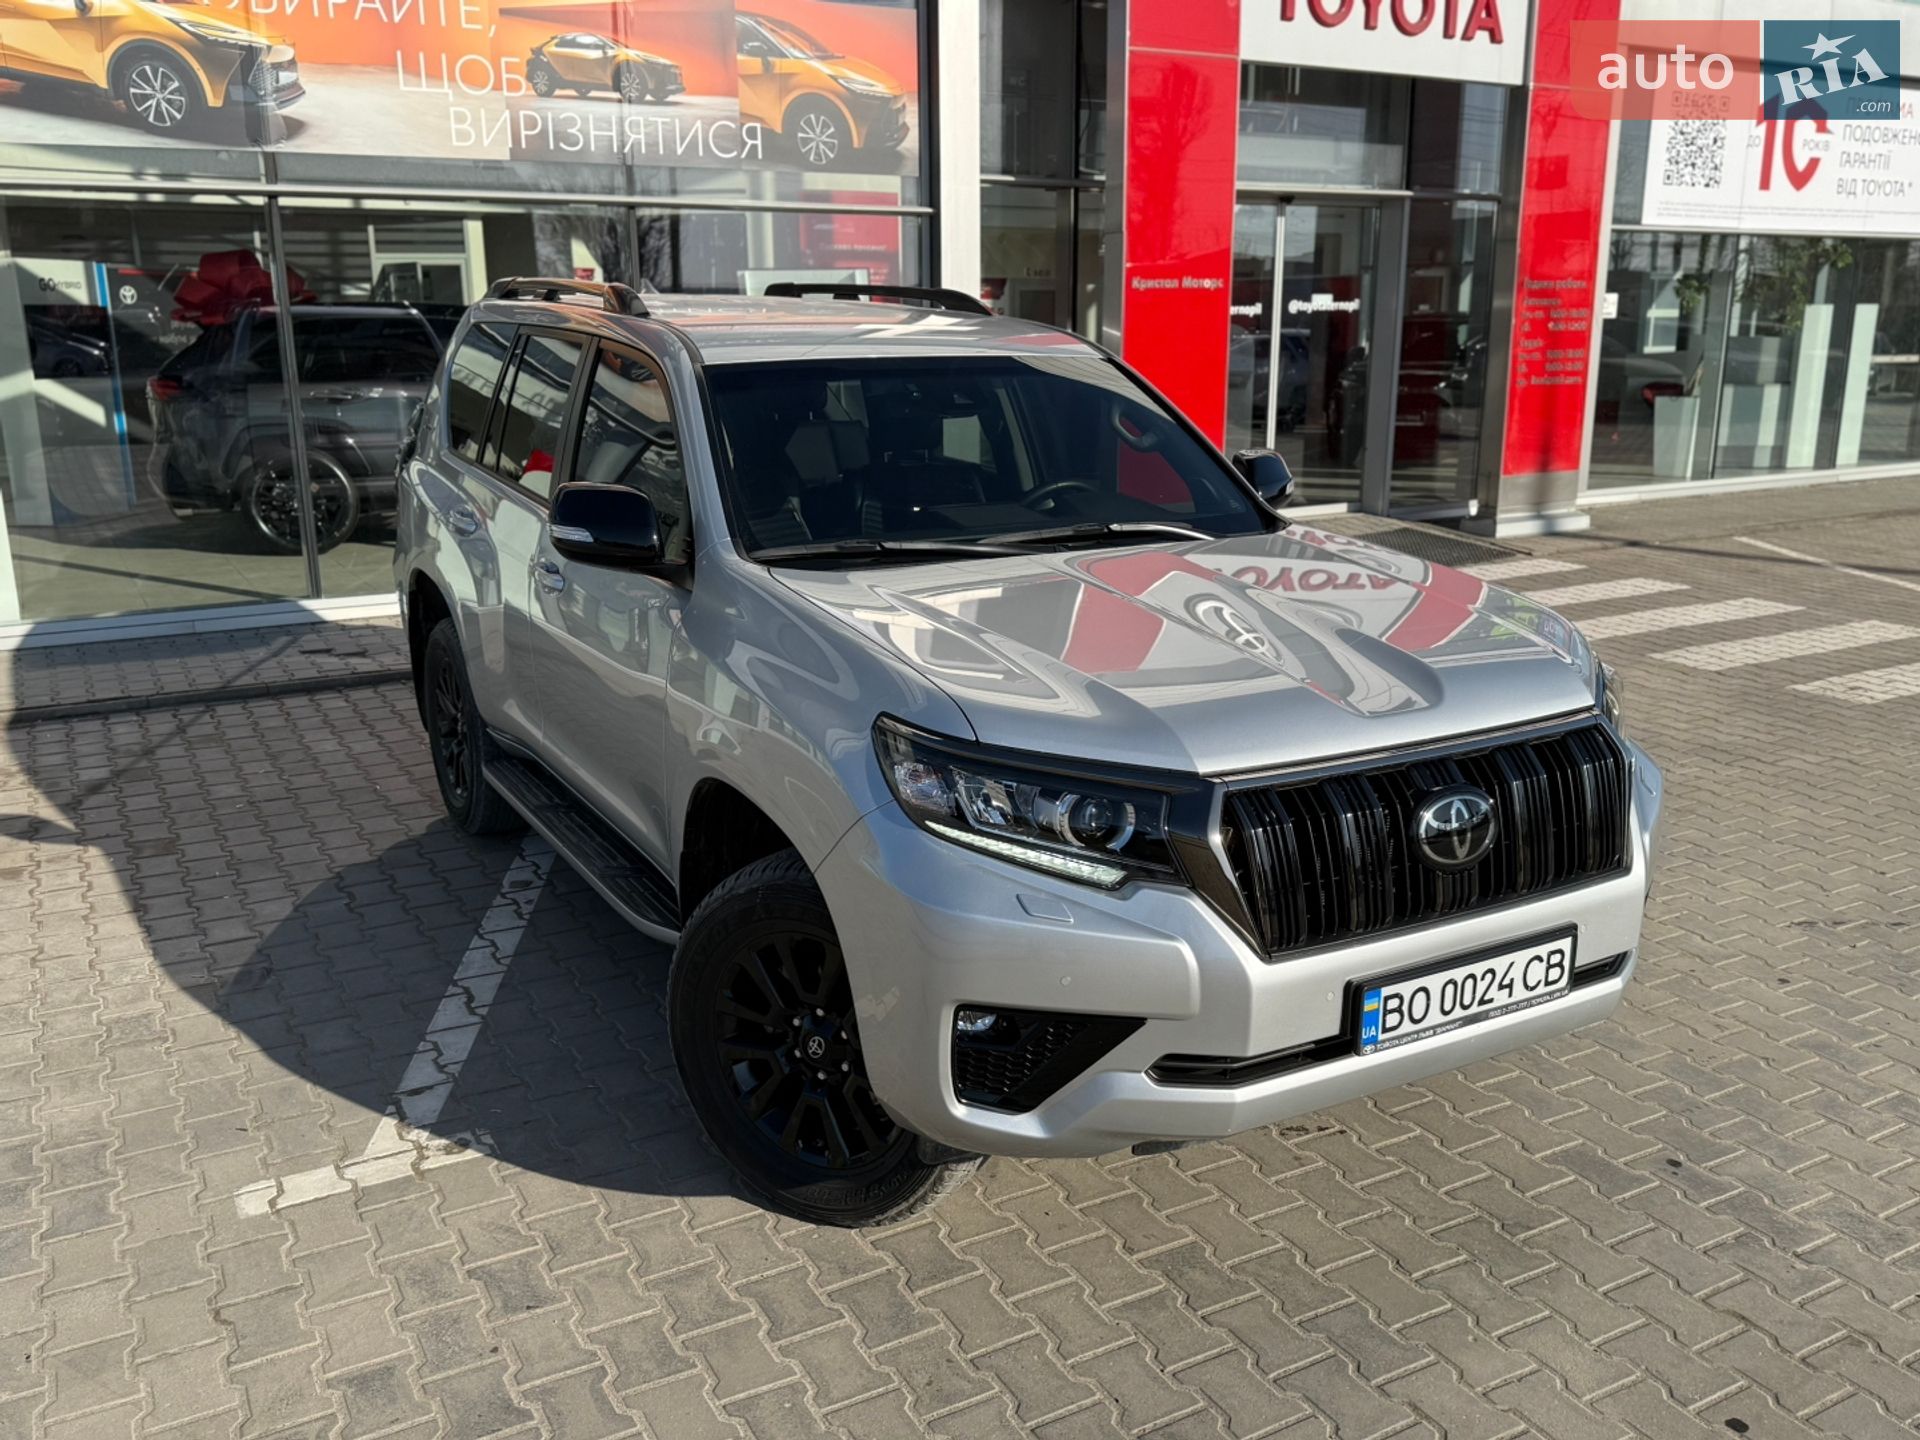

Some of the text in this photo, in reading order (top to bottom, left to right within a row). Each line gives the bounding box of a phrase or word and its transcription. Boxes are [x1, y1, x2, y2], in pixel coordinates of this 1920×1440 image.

[396, 50, 527, 101] ЩОБ
[449, 107, 764, 160] ВИРІЗНЯТИСЯ
[1842, 123, 1920, 147] ПОДОВЖЕН
[1839, 149, 1893, 171] ГАРАНТІЇ
[1836, 178, 1857, 198] ВІД
[1381, 948, 1565, 1034] BO 0024 CB
[1362, 1026, 1377, 1039] UA
